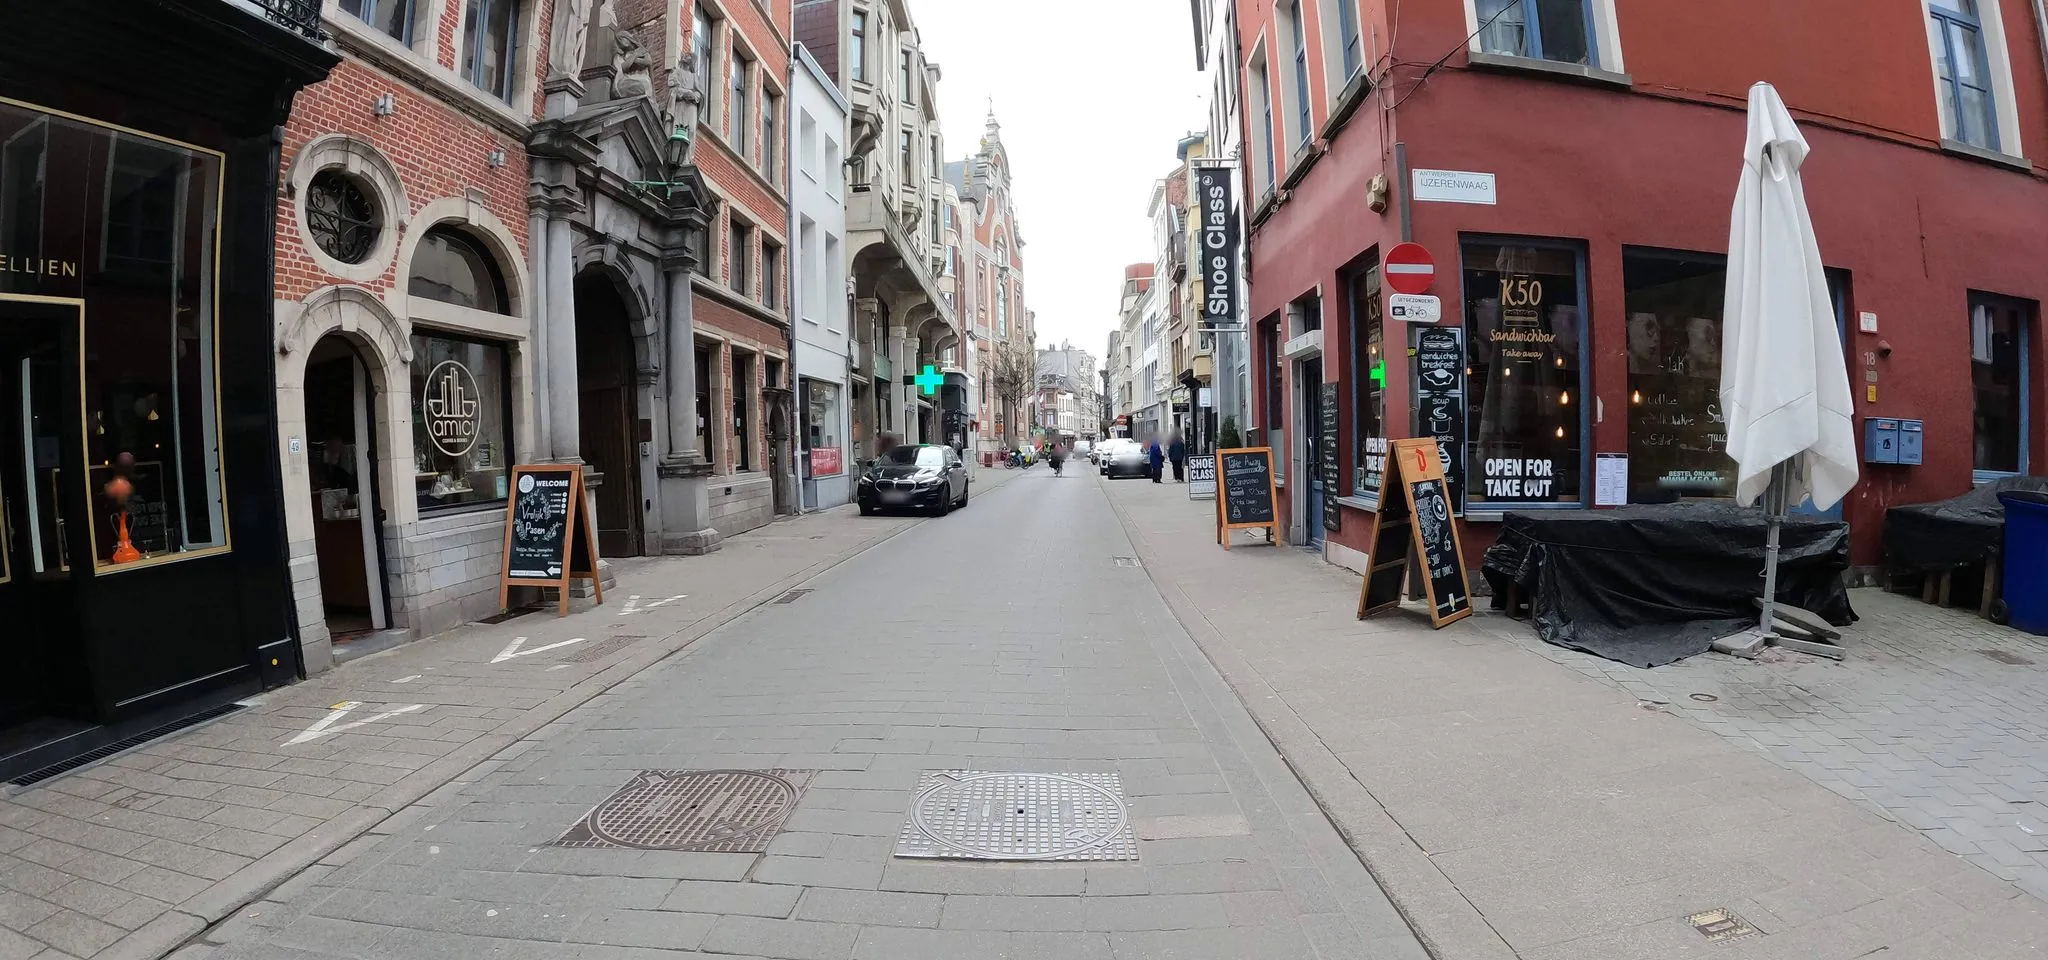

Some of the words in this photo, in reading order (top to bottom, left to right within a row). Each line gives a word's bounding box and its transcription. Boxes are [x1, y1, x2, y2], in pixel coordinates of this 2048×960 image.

[1420, 178, 1488, 190] IJZERENWAAG
[1206, 185, 1227, 249] Class
[1208, 255, 1229, 315] Shoe
[1500, 279, 1542, 306] K50
[1489, 328, 1556, 343] Sandwichbar
[1421, 352, 1458, 360] sandwiches
[1863, 352, 1876, 365] 18
[1421, 360, 1455, 369] breakfast
[1432, 398, 1450, 406] soup
[433, 420, 475, 437] amici
[1190, 458, 1214, 469] SHOE
[1485, 458, 1522, 477] OPEN
[1525, 459, 1553, 477] FOR
[1191, 469, 1214, 479] CLASS
[1485, 479, 1521, 497] TAKE
[1524, 479, 1552, 497] OUT
[521, 505, 544, 521] Vrolijk
[526, 522, 546, 535] Pasen
